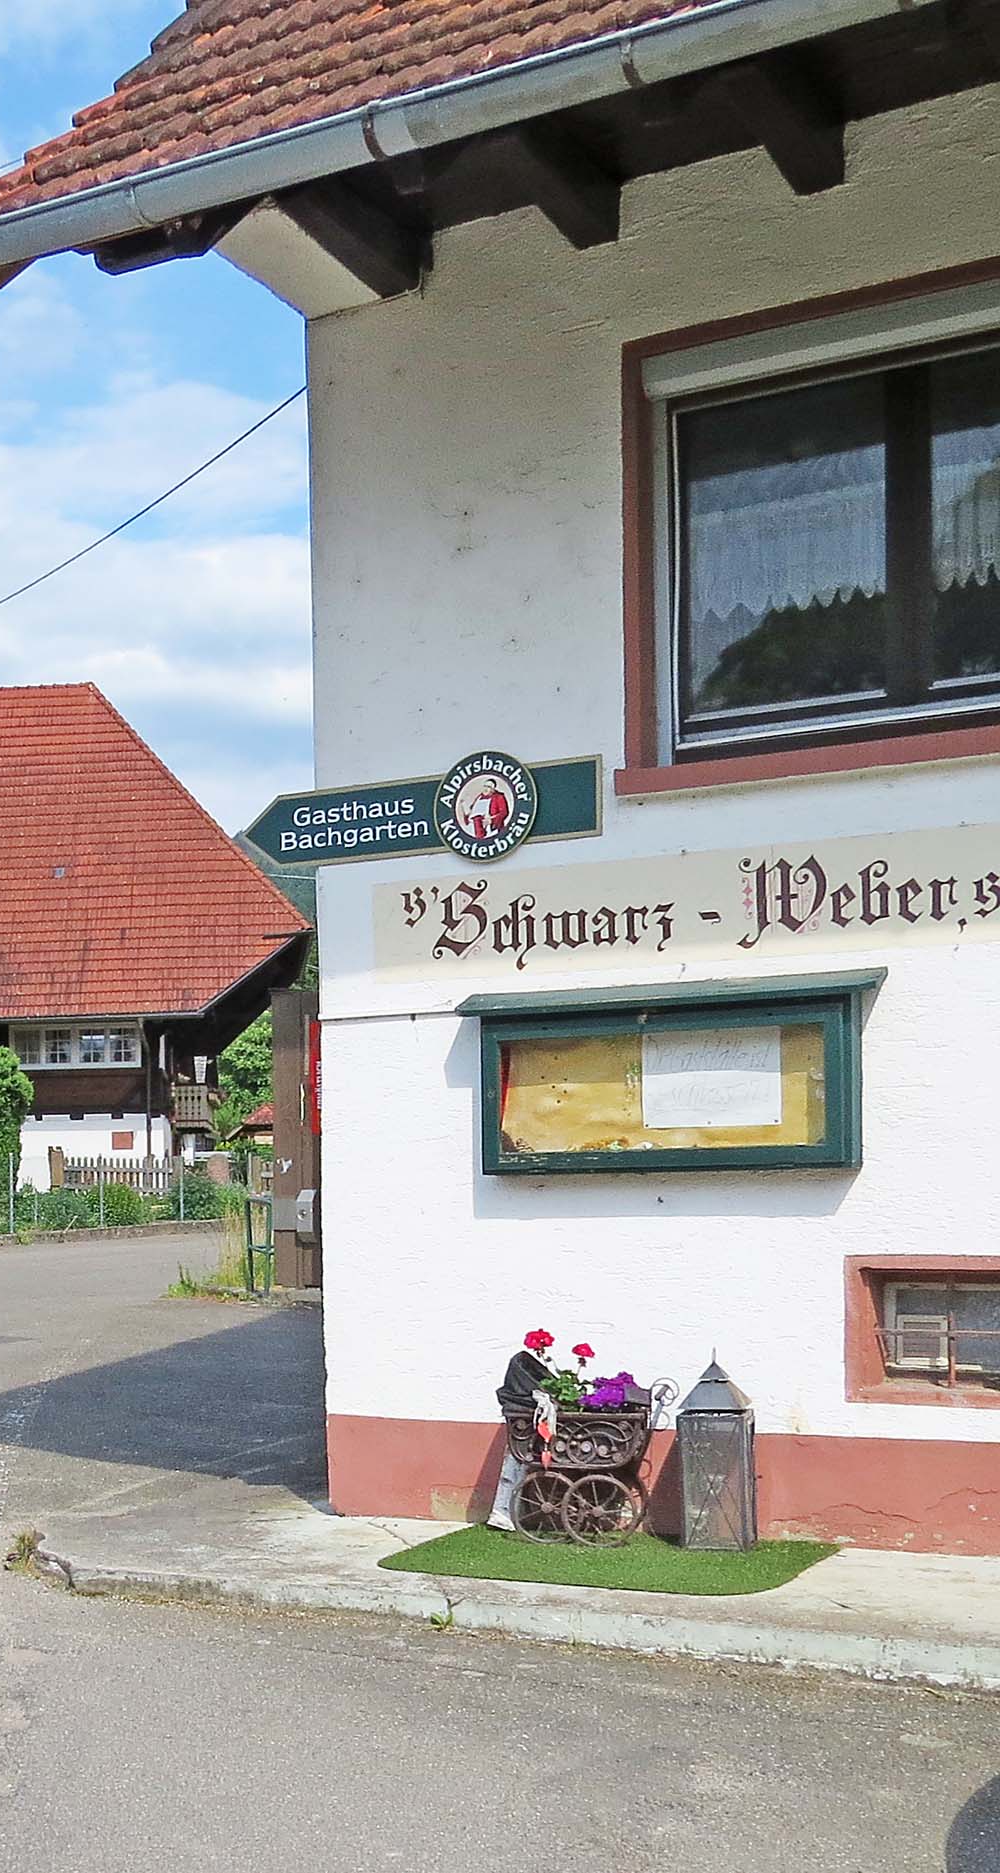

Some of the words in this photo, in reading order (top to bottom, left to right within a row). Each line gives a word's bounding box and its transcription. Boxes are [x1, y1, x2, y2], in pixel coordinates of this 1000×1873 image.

[440, 755, 531, 808] Alpirsbacher
[293, 798, 415, 827] Gasthaus
[280, 819, 430, 851] Bachgarten
[440, 812, 531, 858] Klosterbräu
